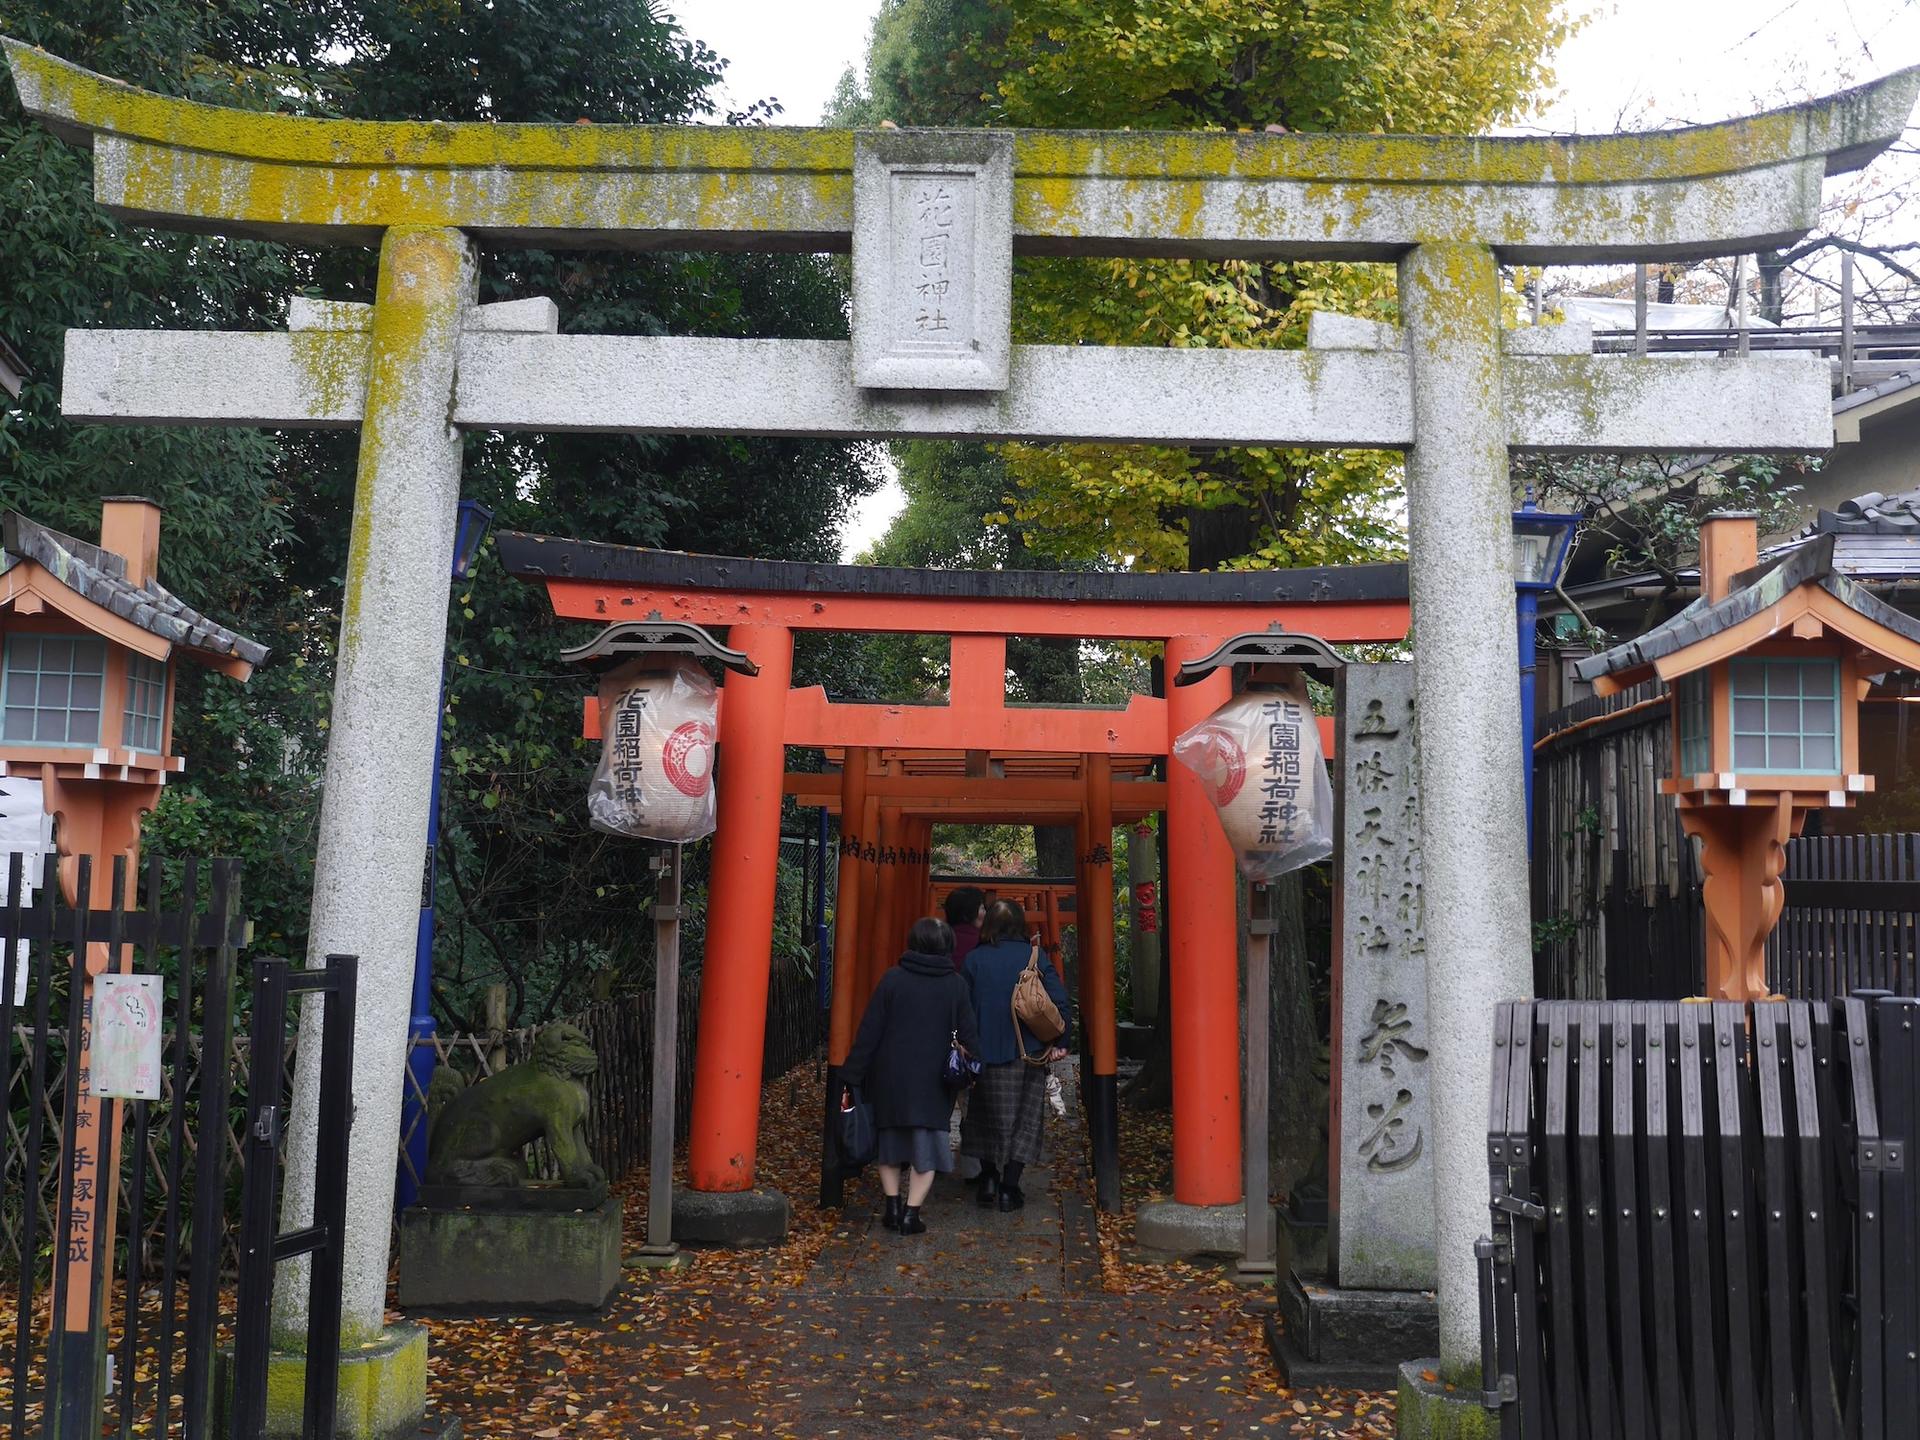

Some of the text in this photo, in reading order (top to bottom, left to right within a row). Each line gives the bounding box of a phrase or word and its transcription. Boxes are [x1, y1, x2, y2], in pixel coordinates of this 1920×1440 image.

[914, 187, 954, 332] 花園神社
[1256, 700, 1304, 844] 花園稲荷神社
[1398, 698, 1426, 957] 荷神社
